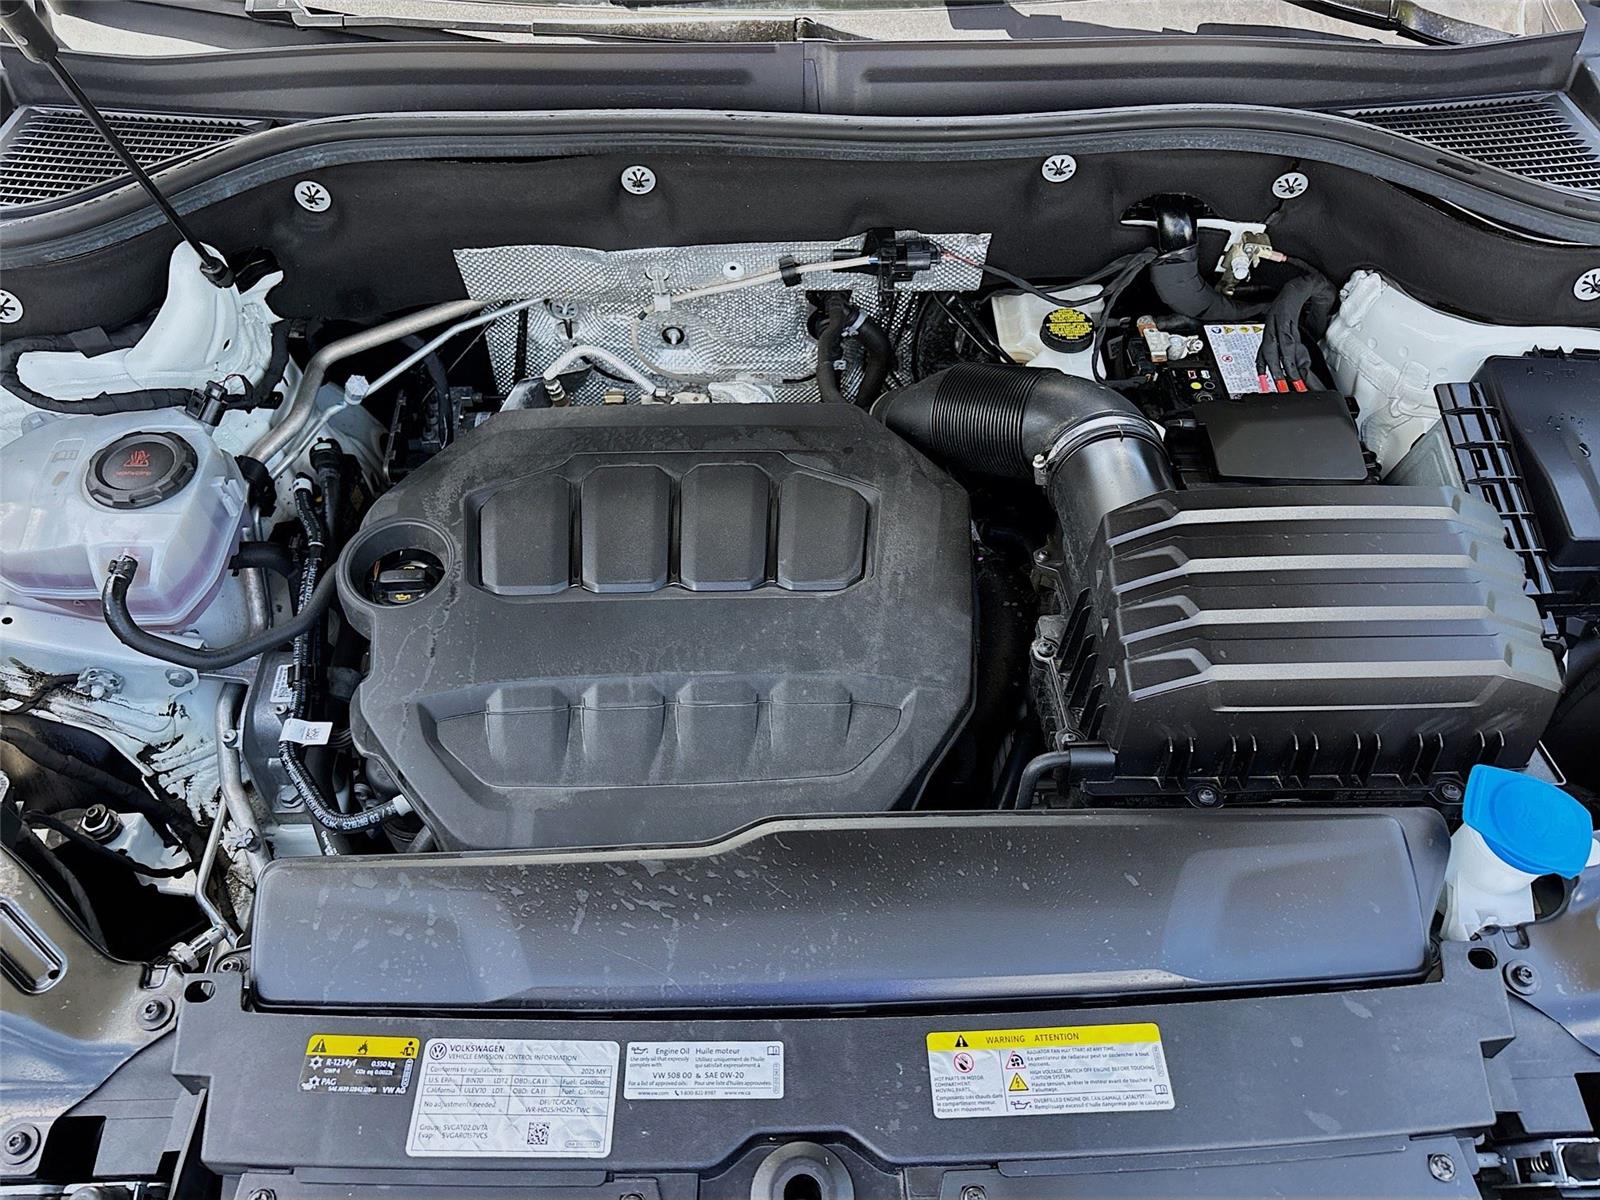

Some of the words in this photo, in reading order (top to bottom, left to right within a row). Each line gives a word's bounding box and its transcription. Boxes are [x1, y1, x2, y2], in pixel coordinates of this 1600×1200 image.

[986, 1035, 1025, 1044] WARNING
[1034, 1032, 1079, 1041] ATTENTION
[450, 1044, 505, 1052] VOLKSWAGEN
[656, 1048, 679, 1056] Engine
[325, 1059, 358, 1068] R-1234yf
[388, 1061, 396, 1069] kg
[321, 1078, 337, 1086] PAG
[382, 1086, 395, 1094] VW
[395, 1086, 406, 1094] AG
